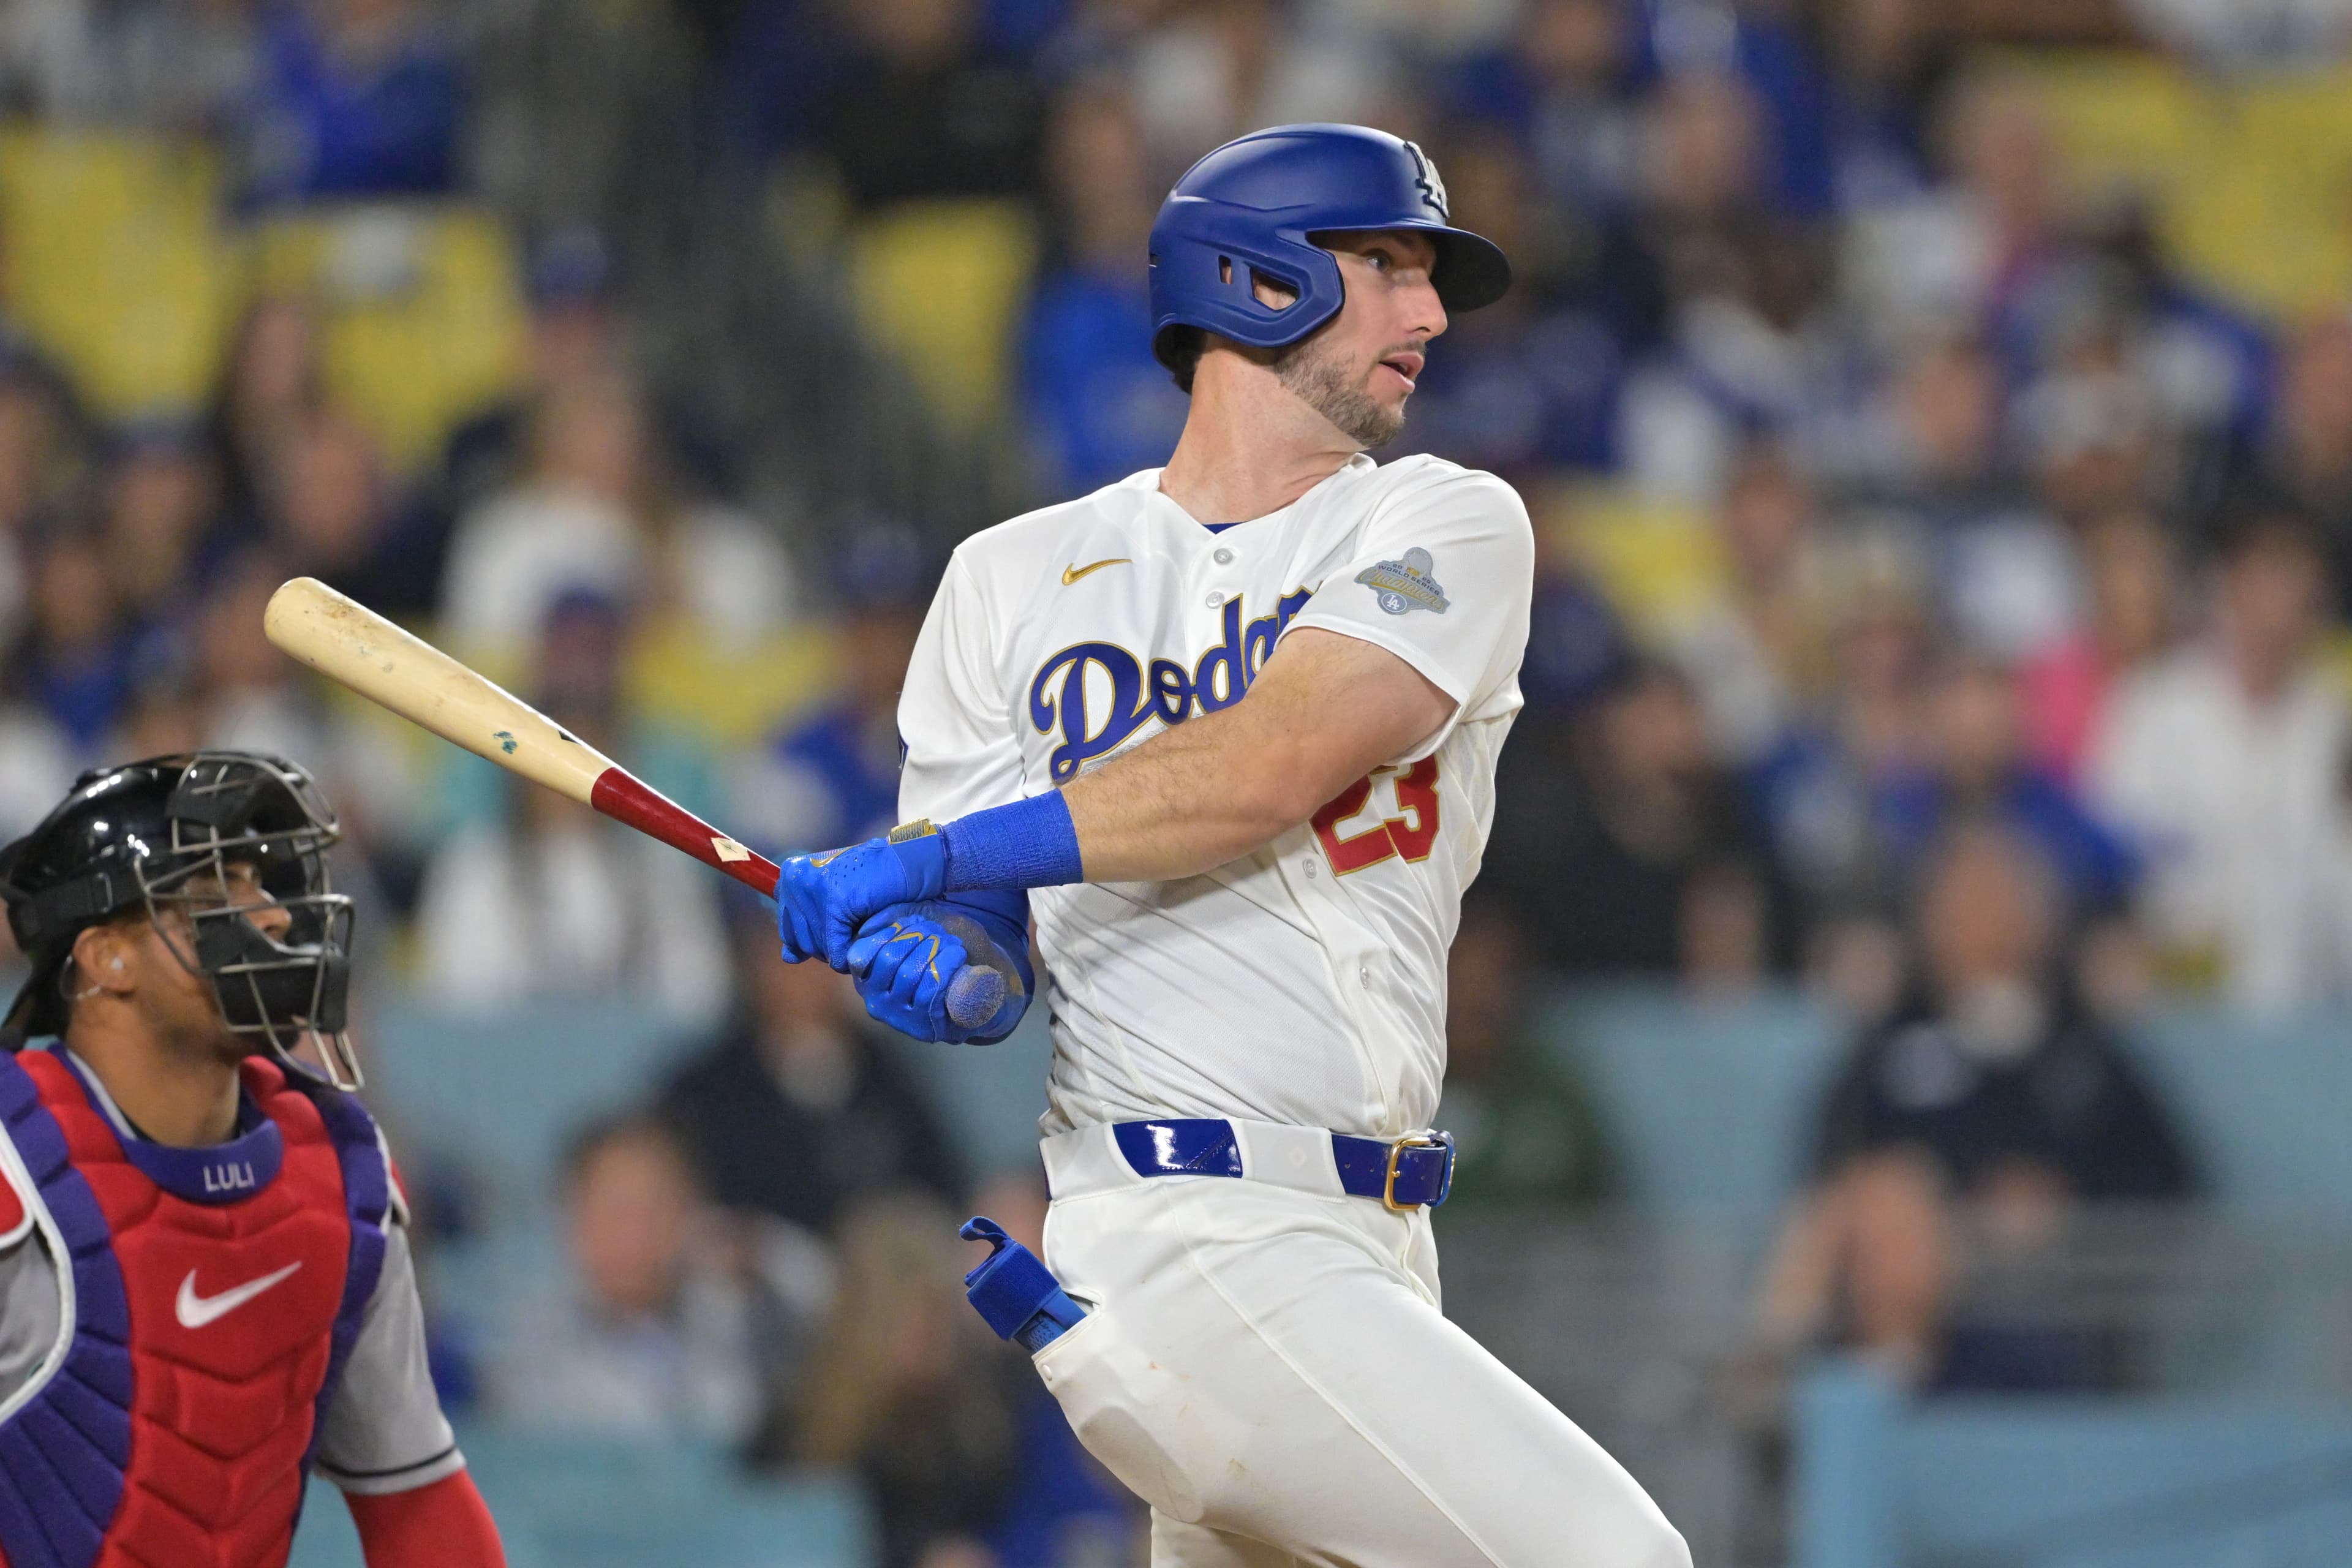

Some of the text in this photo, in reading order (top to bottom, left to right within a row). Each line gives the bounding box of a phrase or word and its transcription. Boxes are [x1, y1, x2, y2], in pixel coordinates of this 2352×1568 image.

[1378, 565, 1439, 595] WORLD SERIES
[1387, 594, 1400, 610] LA
[1308, 753, 1440, 878] 23
[203, 1161, 255, 1192] LULI
